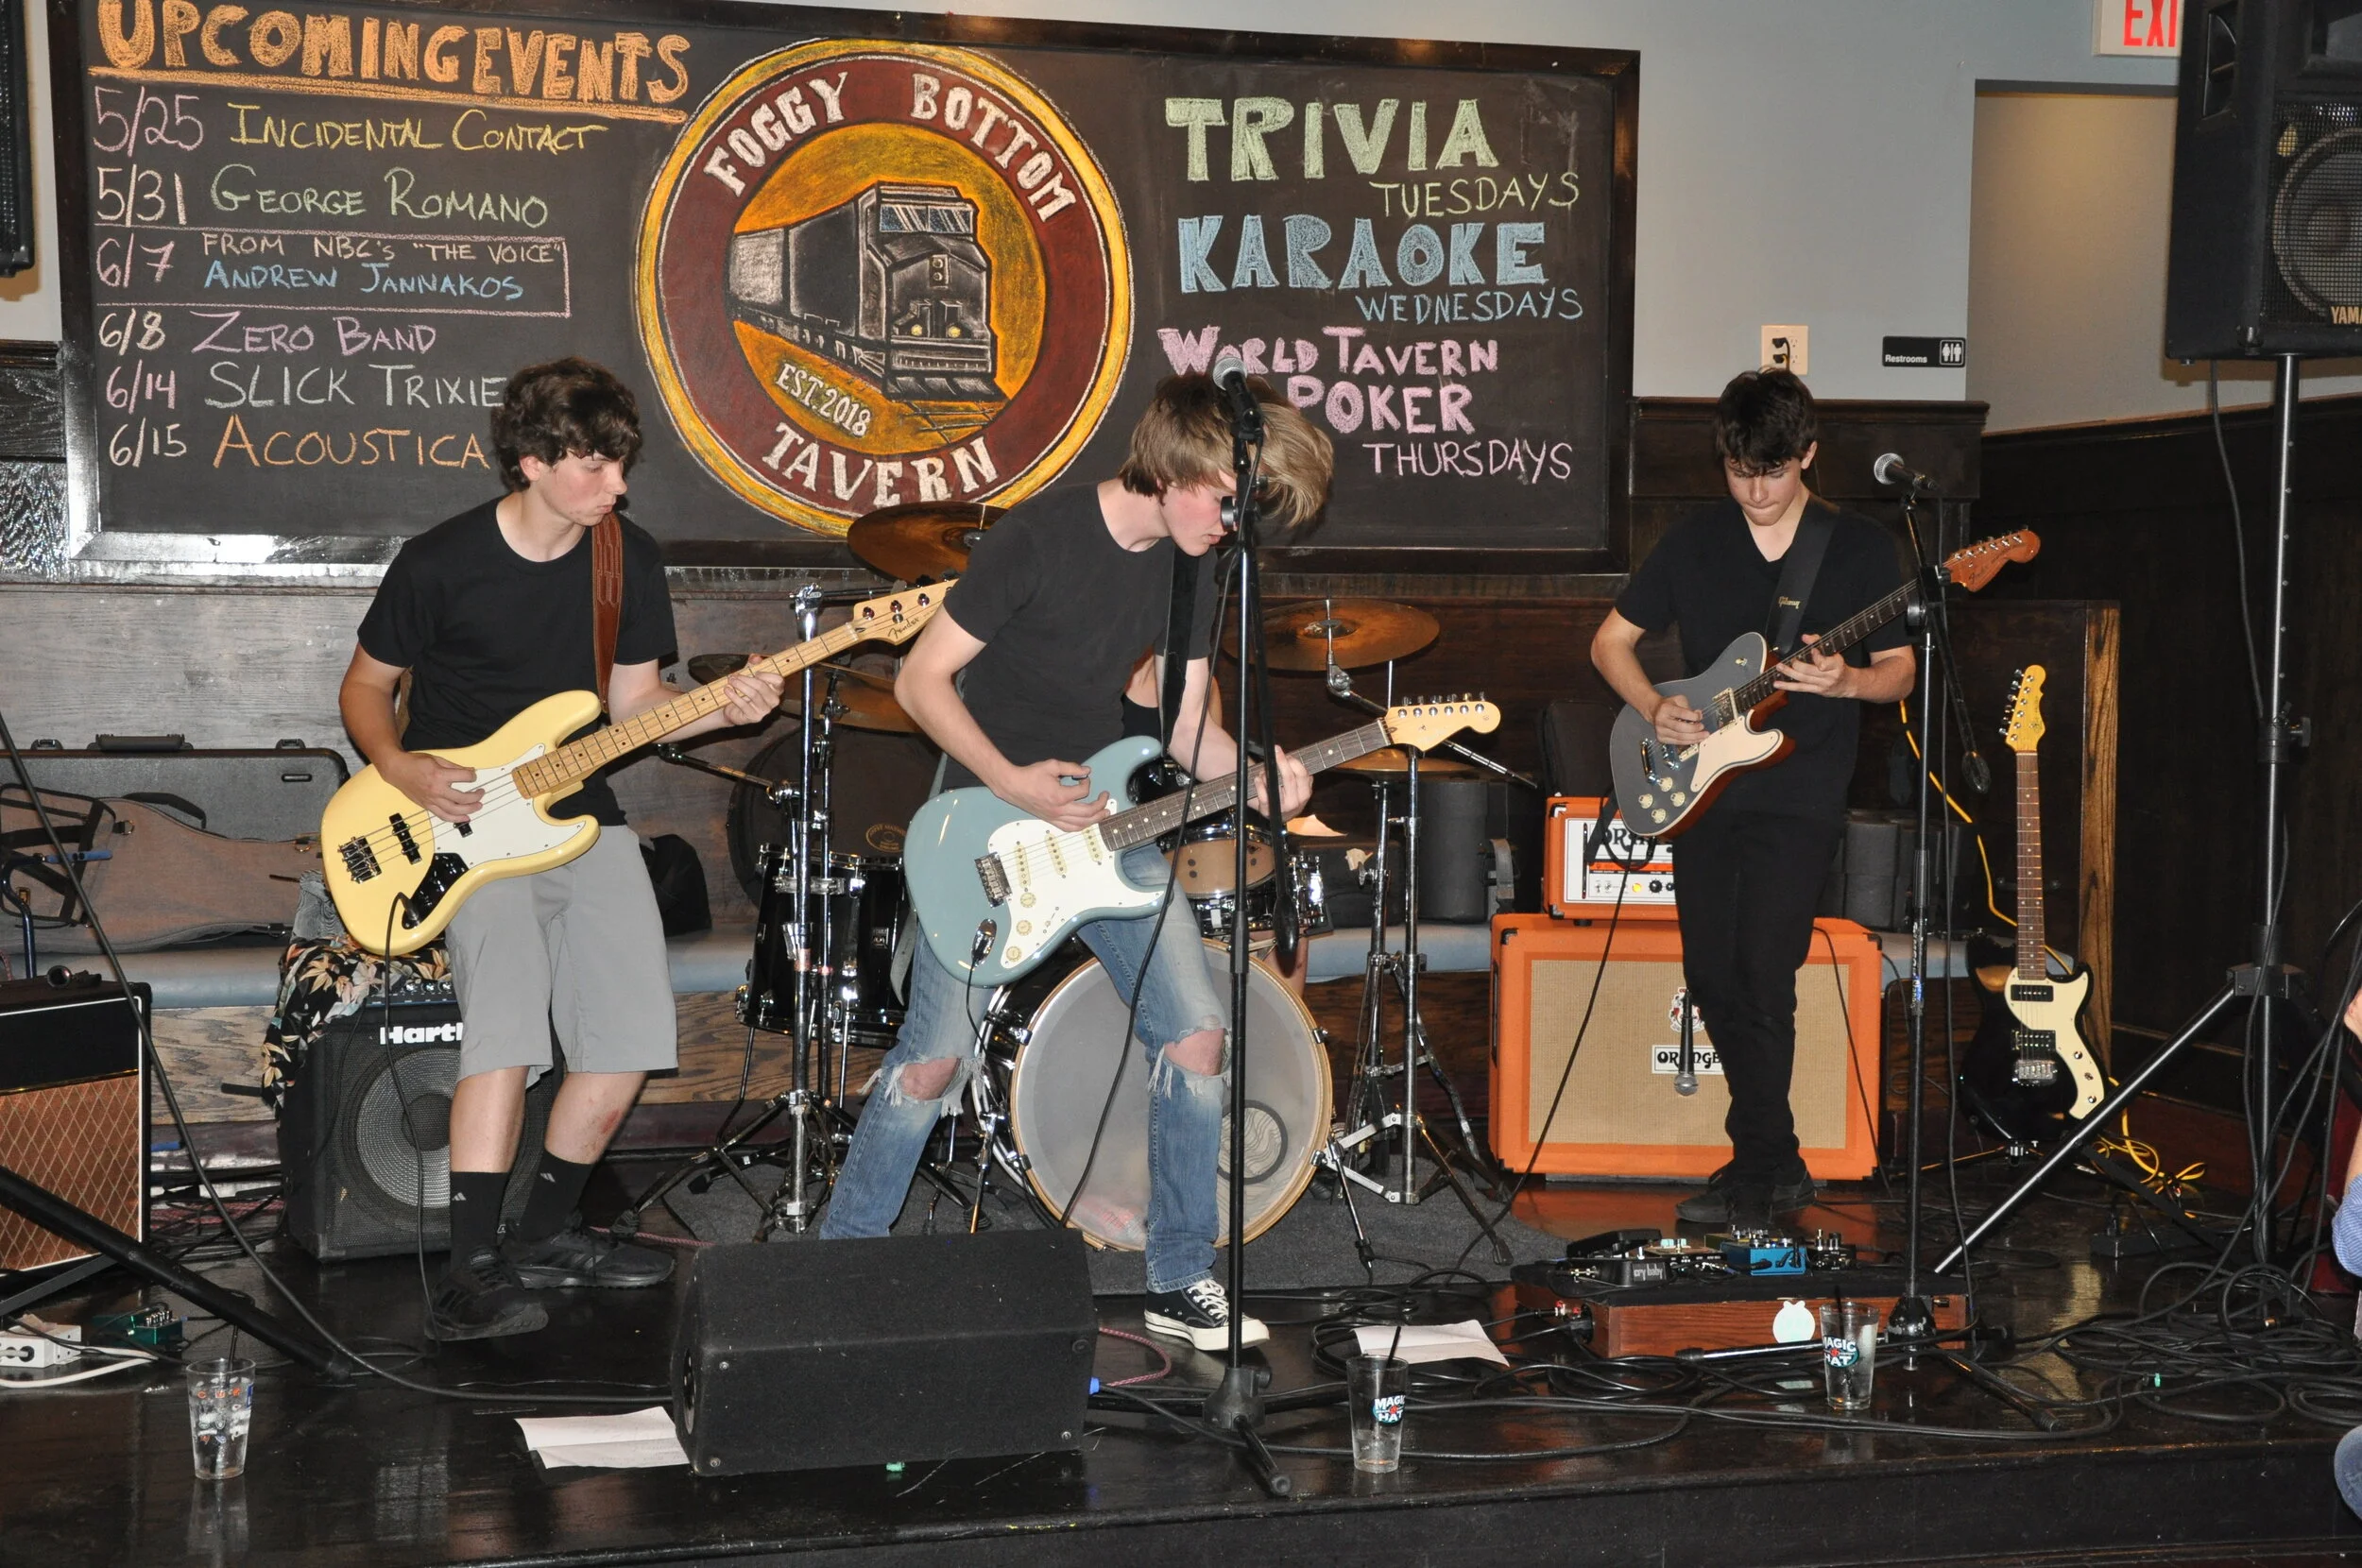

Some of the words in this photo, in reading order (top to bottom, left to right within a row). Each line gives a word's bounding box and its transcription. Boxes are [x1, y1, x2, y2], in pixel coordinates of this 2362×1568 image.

[2123, 0, 2177, 47] EXI
[97, 0, 469, 82] UPCOMING
[473, 26, 691, 103] EVENTS
[94, 86, 204, 157] 5/25
[228, 102, 443, 151] INCIDENTAL
[452, 109, 609, 155] CONTACT
[1165, 97, 1499, 181] TRIVIA
[703, 71, 848, 196] FOGGY
[910, 73, 1077, 222] BOTTOM
[94, 164, 187, 225] 5/31
[211, 163, 366, 216] GEORGE
[385, 167, 548, 228] ROMANO
[1370, 172, 1579, 218] TUESDAYS
[96, 233, 174, 287] 6/7
[201, 232, 284, 256] FROM
[1177, 214, 1549, 294] KARAOKE
[205, 260, 337, 289] ANDREW
[361, 263, 523, 301] JANNAKOS
[1355, 288, 1583, 324] WEDNESDAYS
[2331, 306, 2362, 324] YAM
[99, 308, 165, 356] 6/8
[190, 310, 315, 354] ZERO
[333, 315, 436, 356] BAND
[1322, 326, 1498, 377] TAVERN
[1885, 354, 1927, 364] Restrooms
[106, 359, 176, 415] 6/14
[205, 361, 355, 408] SLICK
[368, 365, 506, 408] TRIXIE
[1287, 376, 1476, 434] POKER
[109, 417, 187, 469] 6/15
[214, 414, 490, 469] ACOUSTICA
[762, 422, 999, 507] TAVERN
[1362, 437, 1573, 484] THURSDAYS
[1657, 1051, 1721, 1069] ORNGE
[1824, 1353, 1852, 1367] HAT
[1378, 1408, 1404, 1423] HAT
